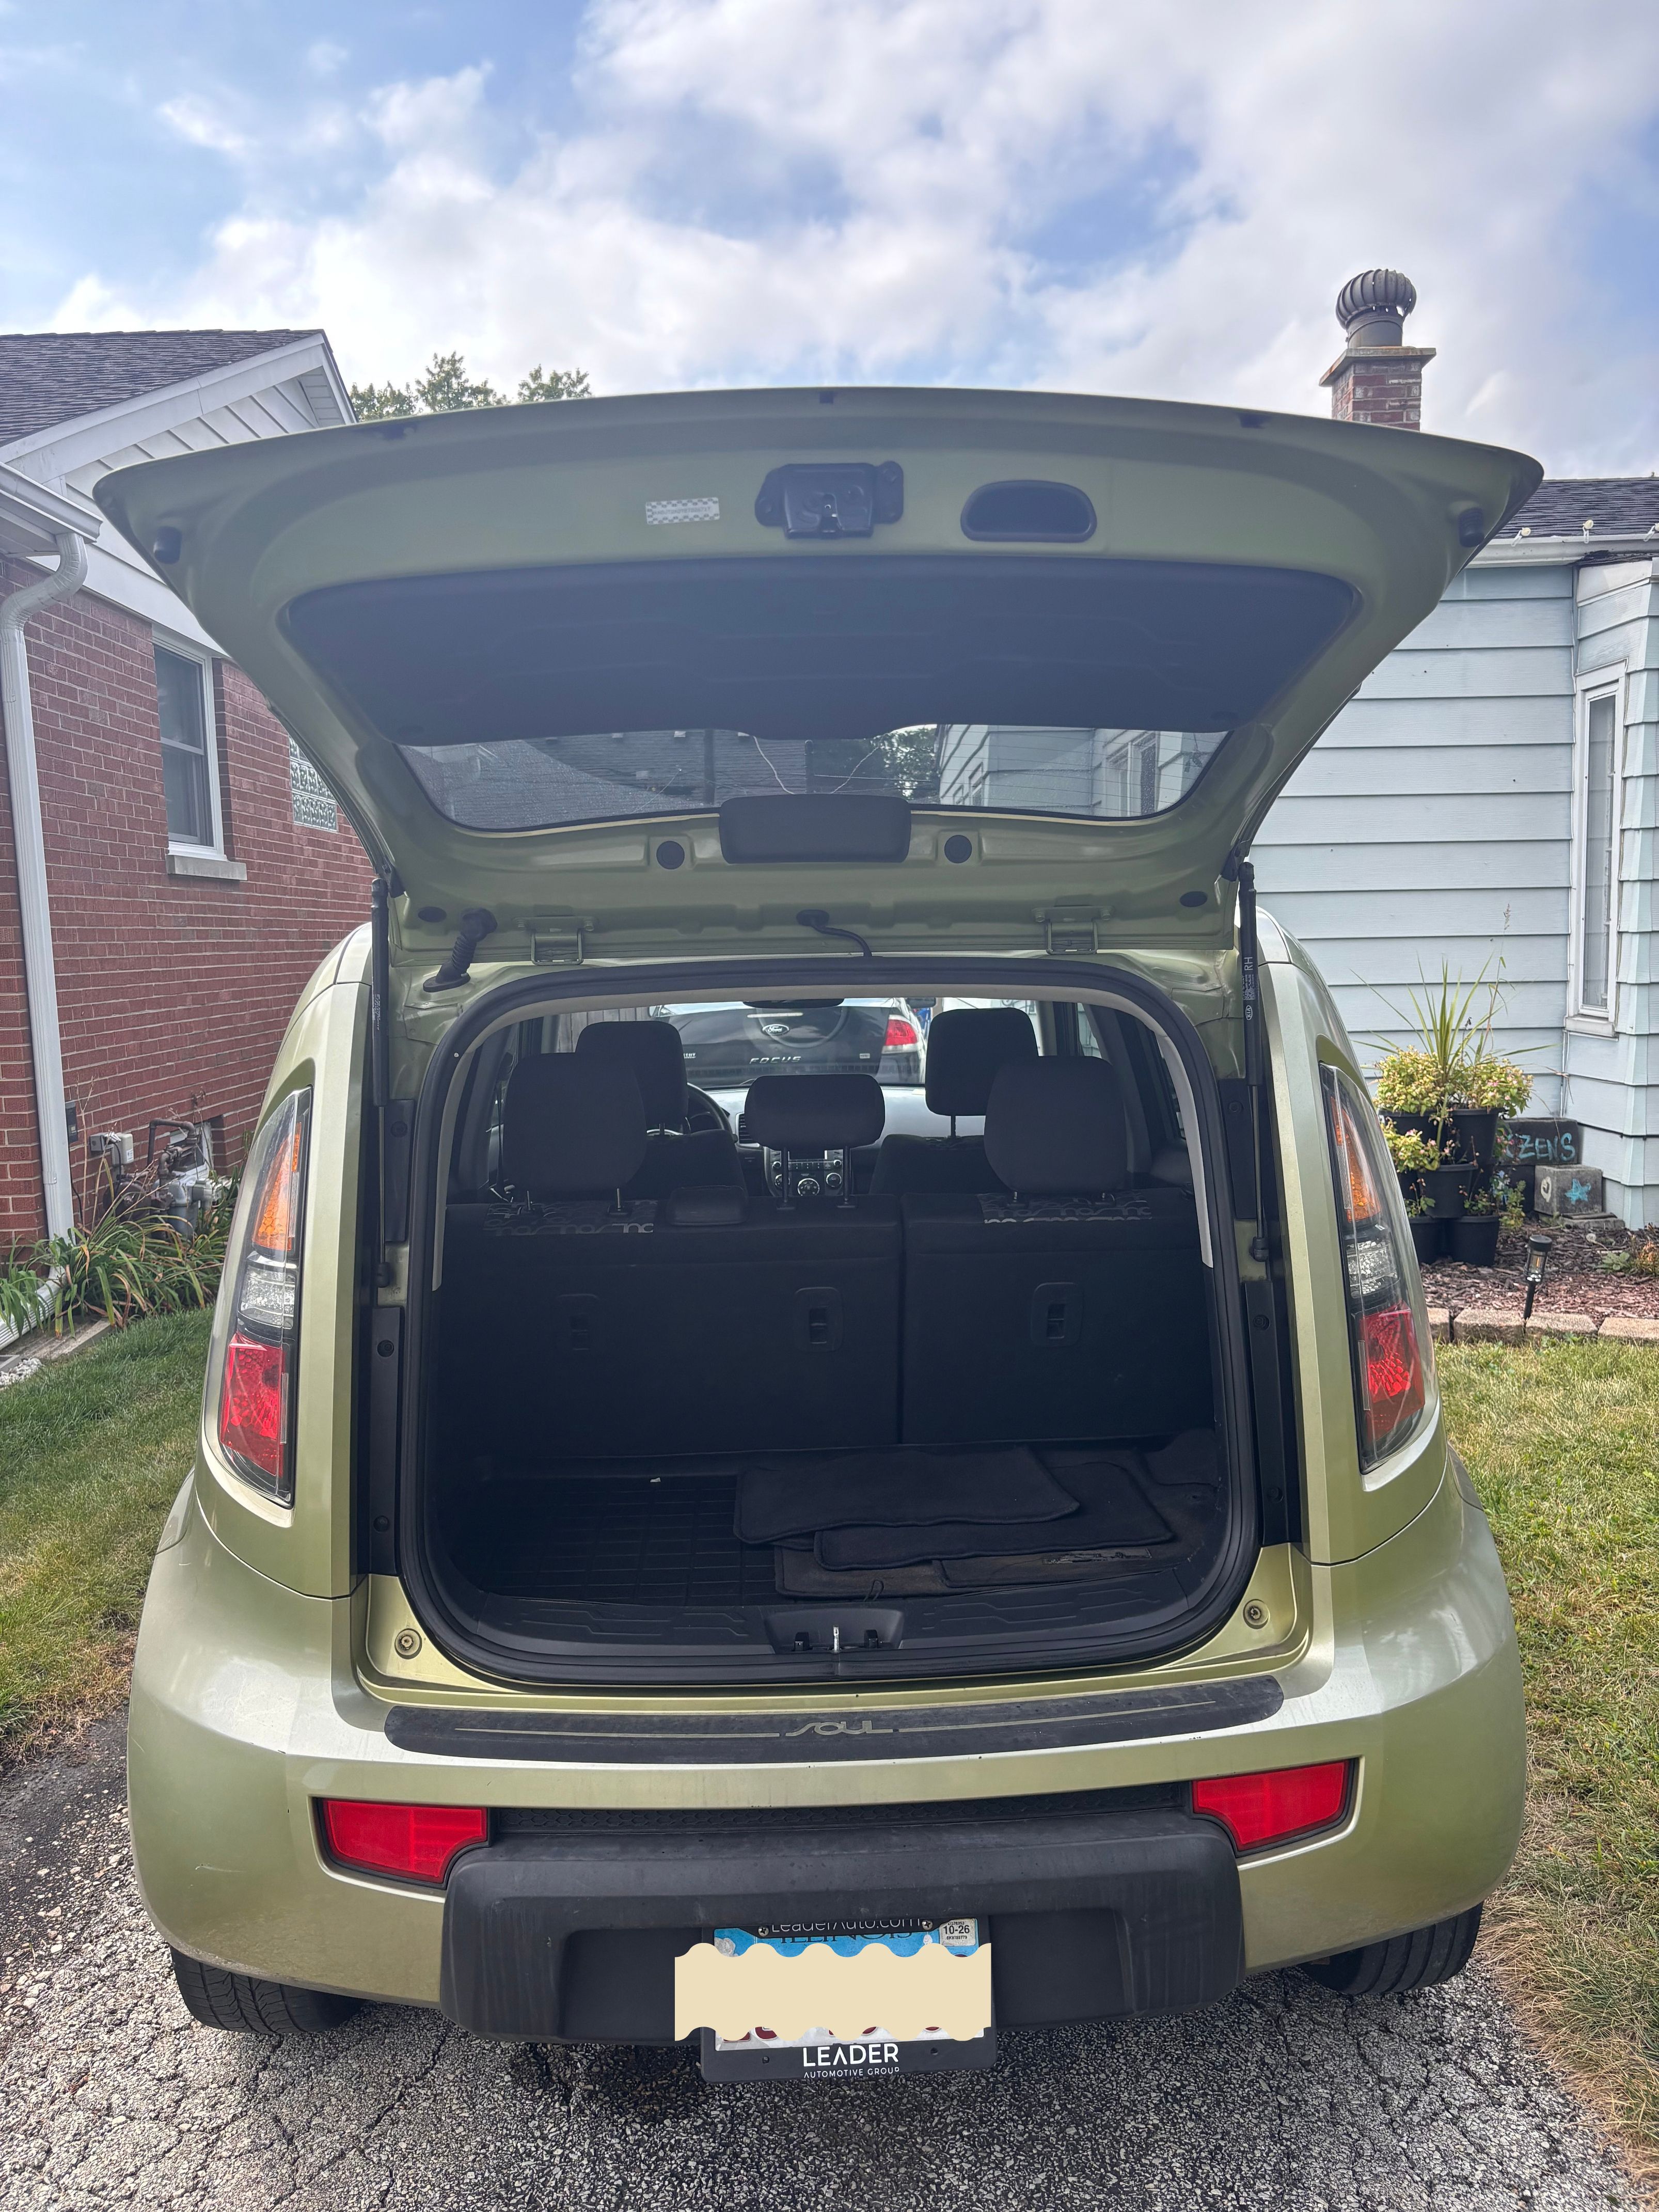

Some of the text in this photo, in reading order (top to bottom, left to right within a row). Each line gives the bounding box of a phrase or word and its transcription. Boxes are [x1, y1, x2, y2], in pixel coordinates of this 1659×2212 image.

[1244, 957, 1253, 971] RH
[749, 1056, 801, 1064] FOCUS
[785, 1720, 893, 1736] SOUL
[943, 1924, 970, 1934] 10-26
[803, 2043, 899, 2067] LEADER
[804, 2066, 899, 2079] AUTOMOTIVE GROUP
